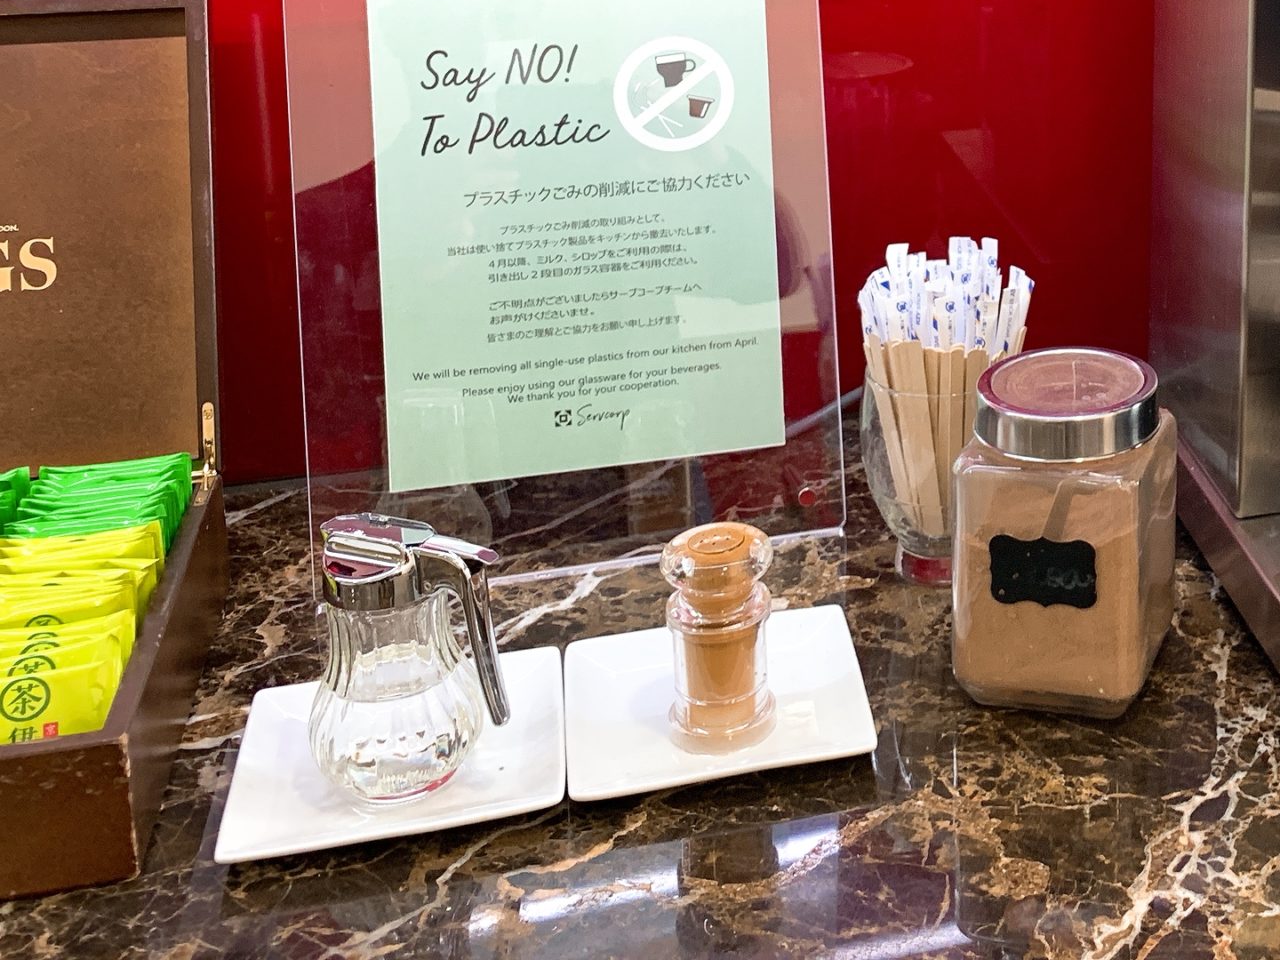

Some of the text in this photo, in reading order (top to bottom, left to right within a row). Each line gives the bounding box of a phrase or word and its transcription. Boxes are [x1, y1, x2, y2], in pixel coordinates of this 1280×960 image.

[420, 44, 578, 101] Say NO!
[421, 112, 610, 156] To Plastic
[463, 172, 750, 207] プラスチックごみの削減にご協力ください
[413, 337, 759, 381] We will be removing all single-use plastics from our kitchen from April.
[462, 362, 722, 397] Please enjoy using our glassware for your beverages.
[507, 378, 679, 403] We thank you for your cooperation.
[576, 404, 630, 430] Servcorp
[7, 684, 42, 715] 茶
